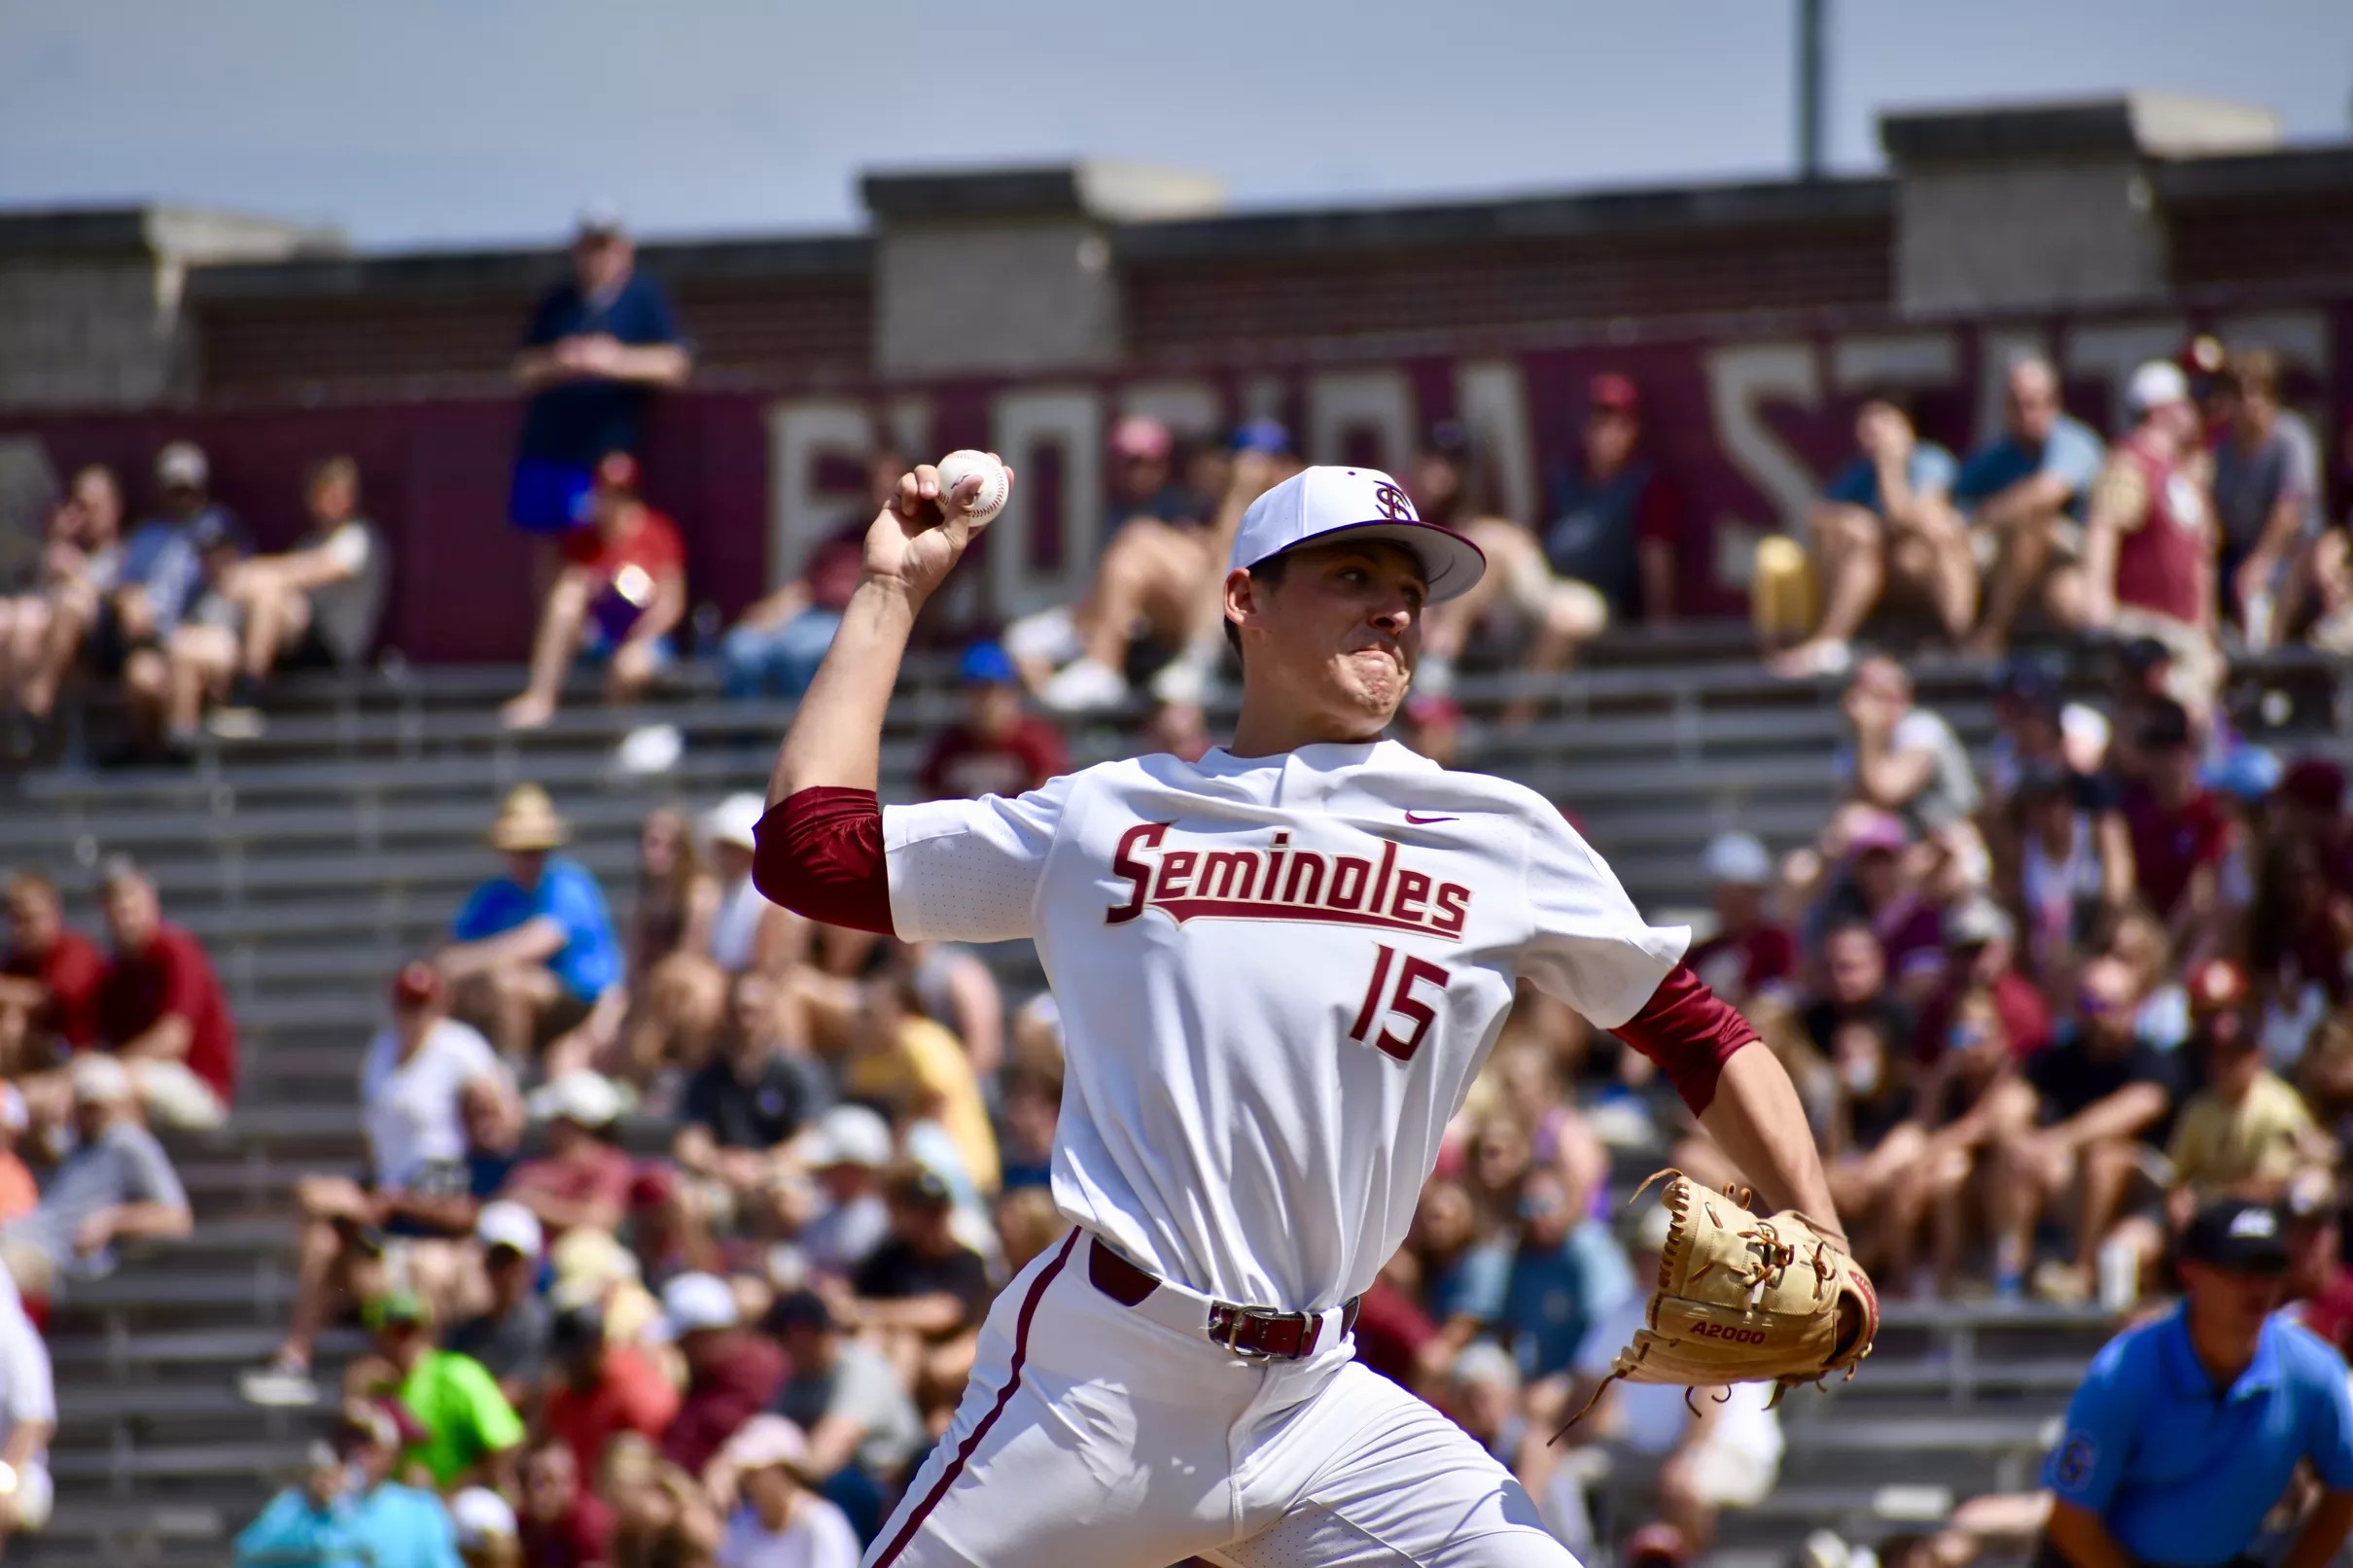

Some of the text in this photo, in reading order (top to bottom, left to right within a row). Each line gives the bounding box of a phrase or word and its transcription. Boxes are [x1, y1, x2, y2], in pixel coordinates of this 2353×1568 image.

[1105, 819, 1474, 933] Seminoles
[1349, 940, 1452, 1063] 15
[1689, 1321, 1767, 1344] A2000
